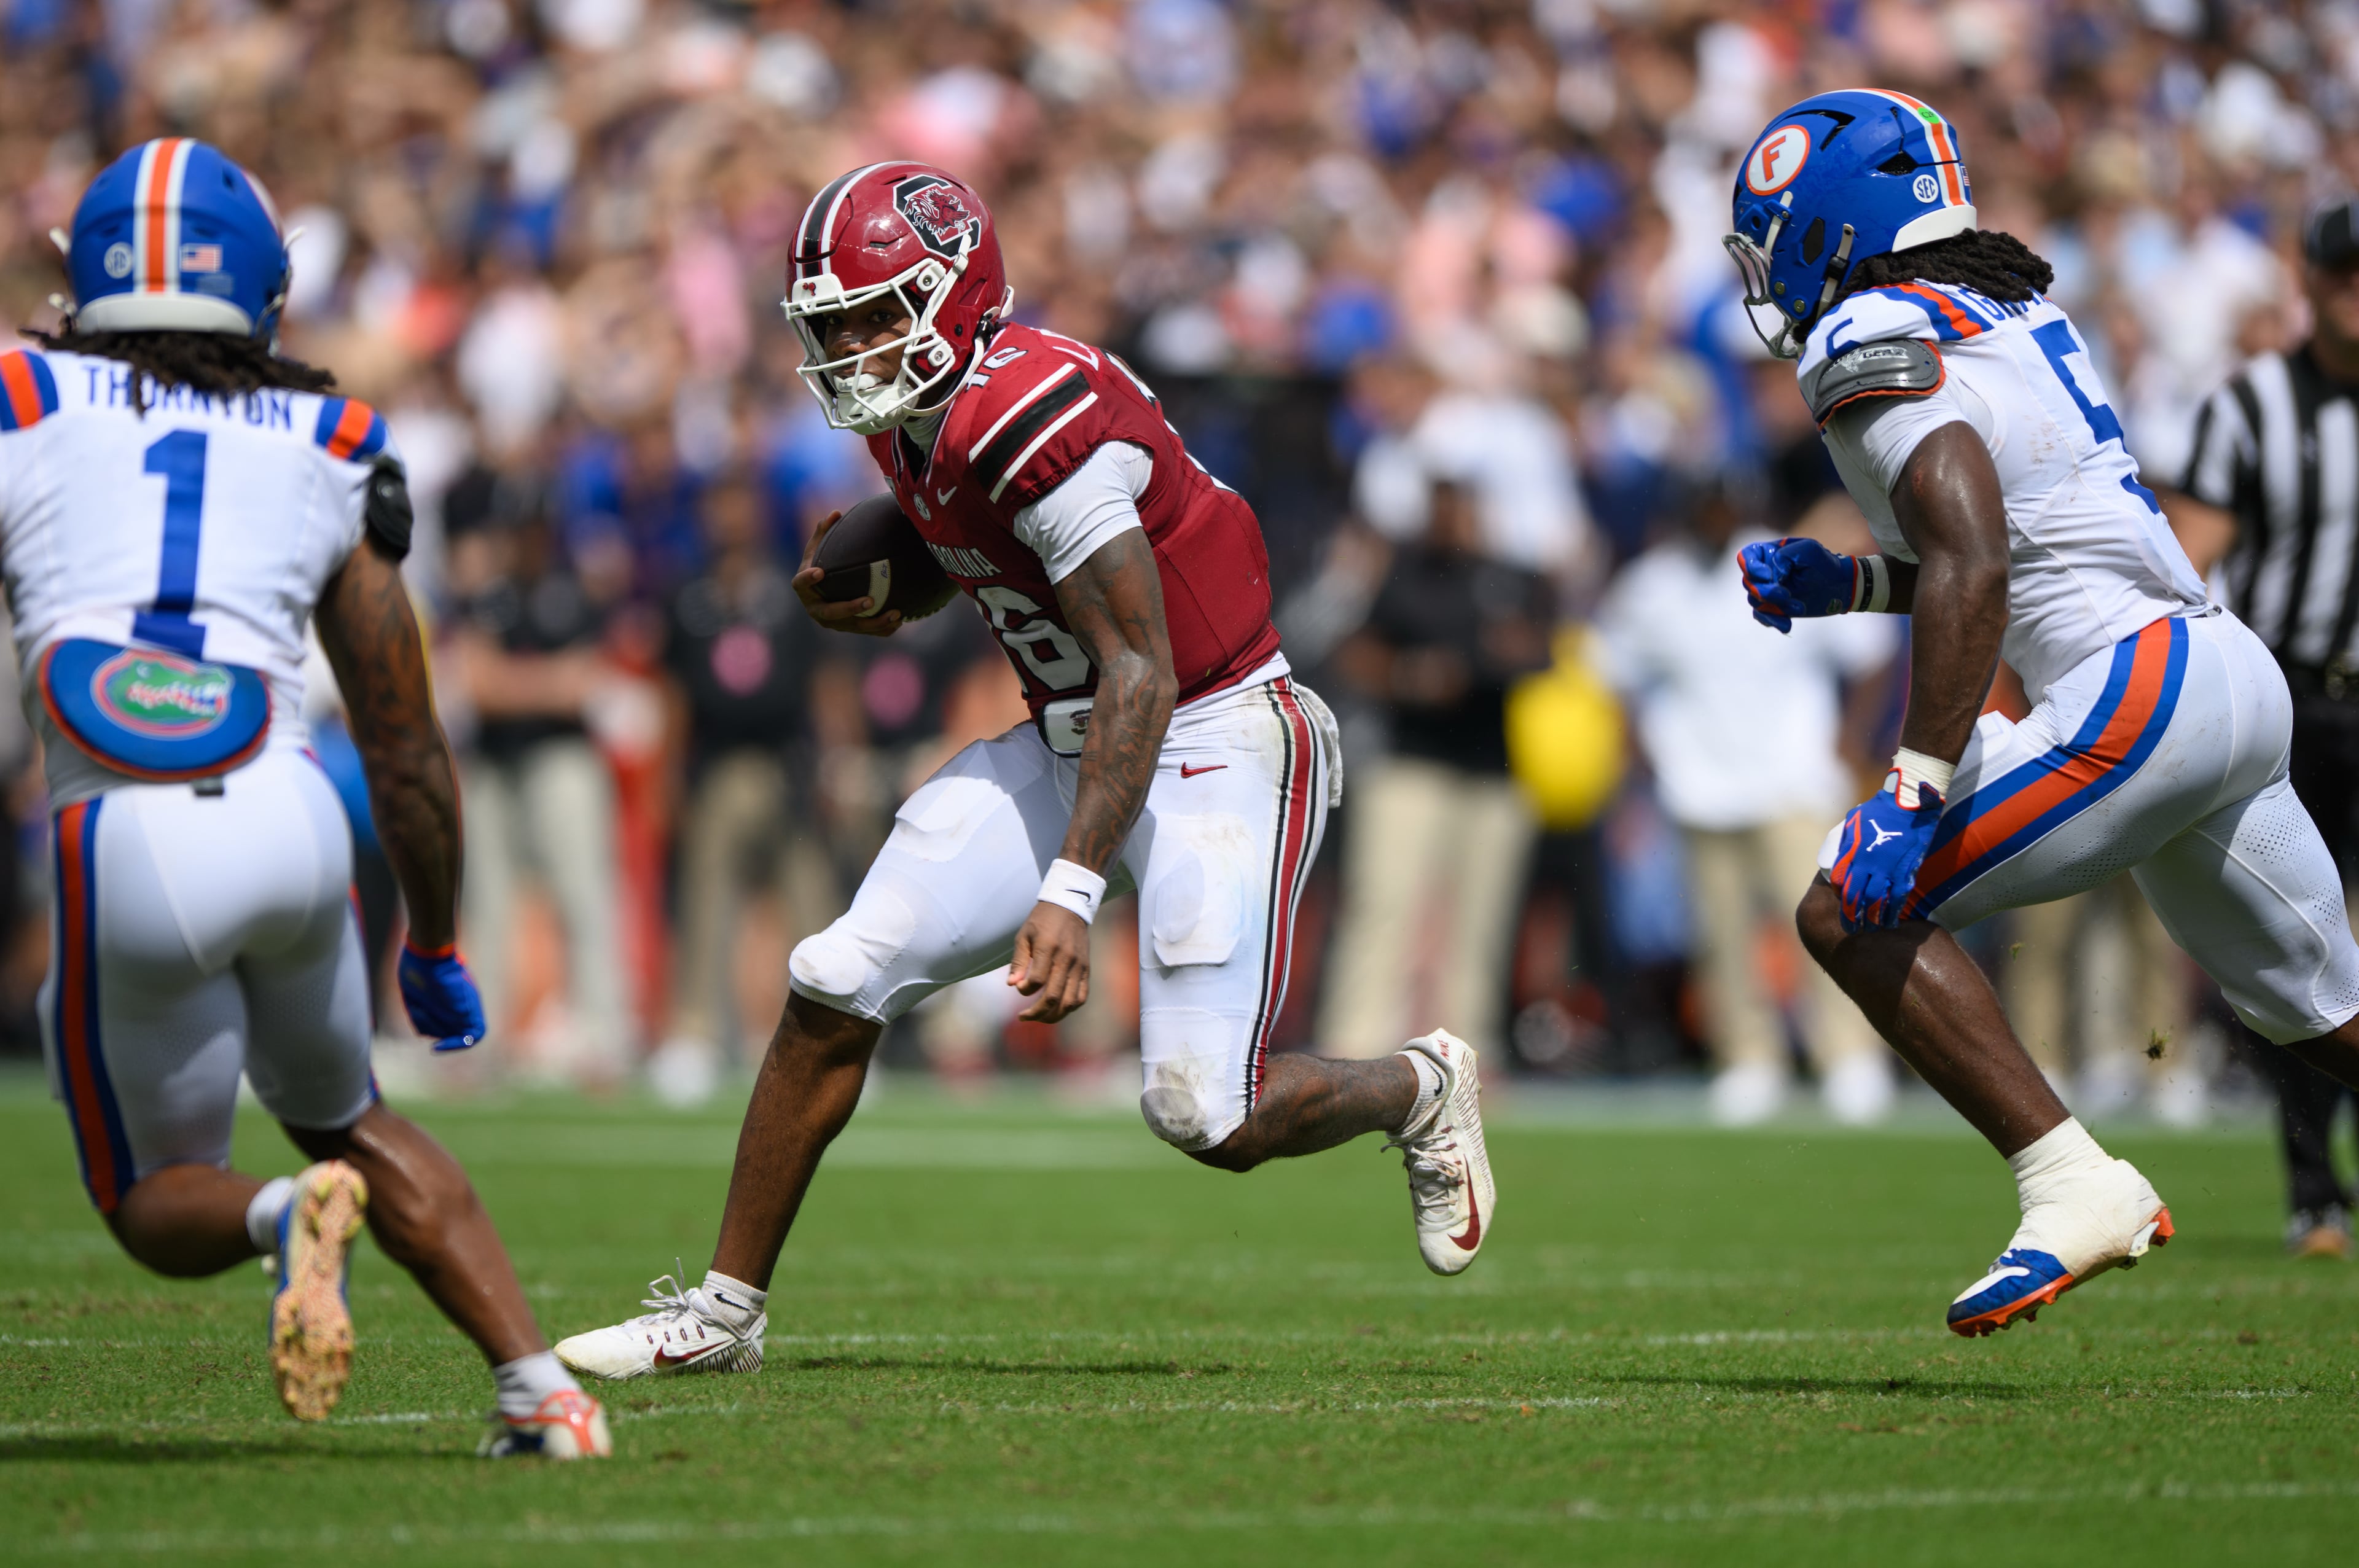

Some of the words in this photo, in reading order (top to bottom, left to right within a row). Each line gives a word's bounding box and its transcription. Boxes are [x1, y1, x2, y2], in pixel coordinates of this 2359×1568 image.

[1762, 135, 1786, 183] F
[1916, 177, 1936, 199] SEC
[131, 429, 208, 661] 1
